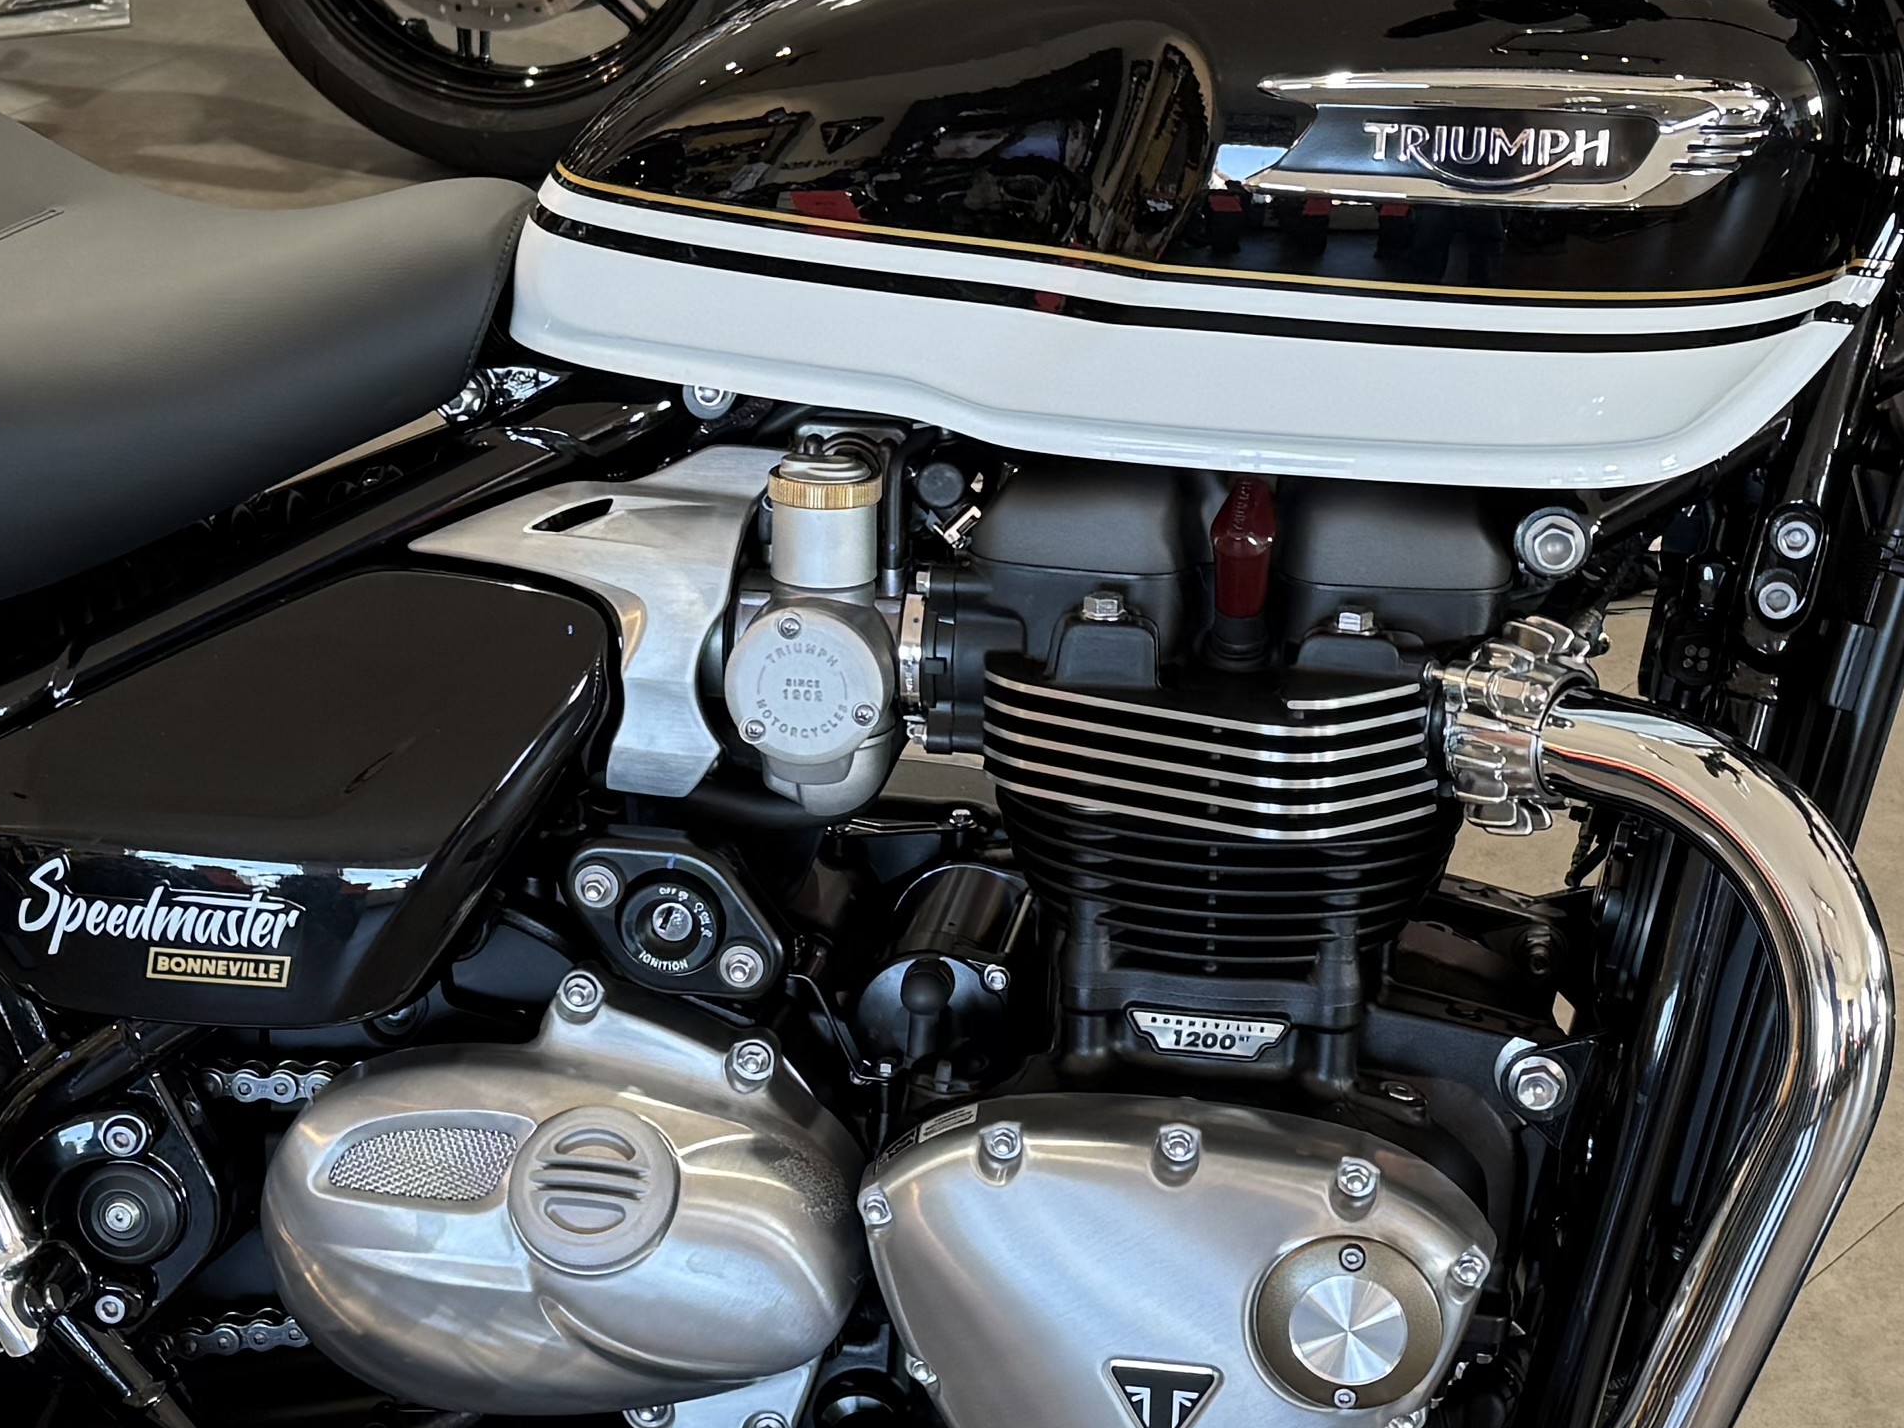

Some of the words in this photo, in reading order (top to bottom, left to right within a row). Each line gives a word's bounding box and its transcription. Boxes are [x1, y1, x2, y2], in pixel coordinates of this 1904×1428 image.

[1363, 121, 1612, 184] TRIUMPH
[765, 643, 839, 667] TRIUMPH
[785, 678, 820, 689] SINCE
[782, 689, 824, 702] 1902
[756, 699, 849, 738] MOTORCYCLES
[18, 857, 306, 955] Speedmaster
[156, 955, 283, 980] BONNEVILLE
[638, 950, 689, 971] IGNITION
[1150, 1016, 1266, 1033] BONNEVILLE
[1173, 1029, 1237, 1050] 1200
